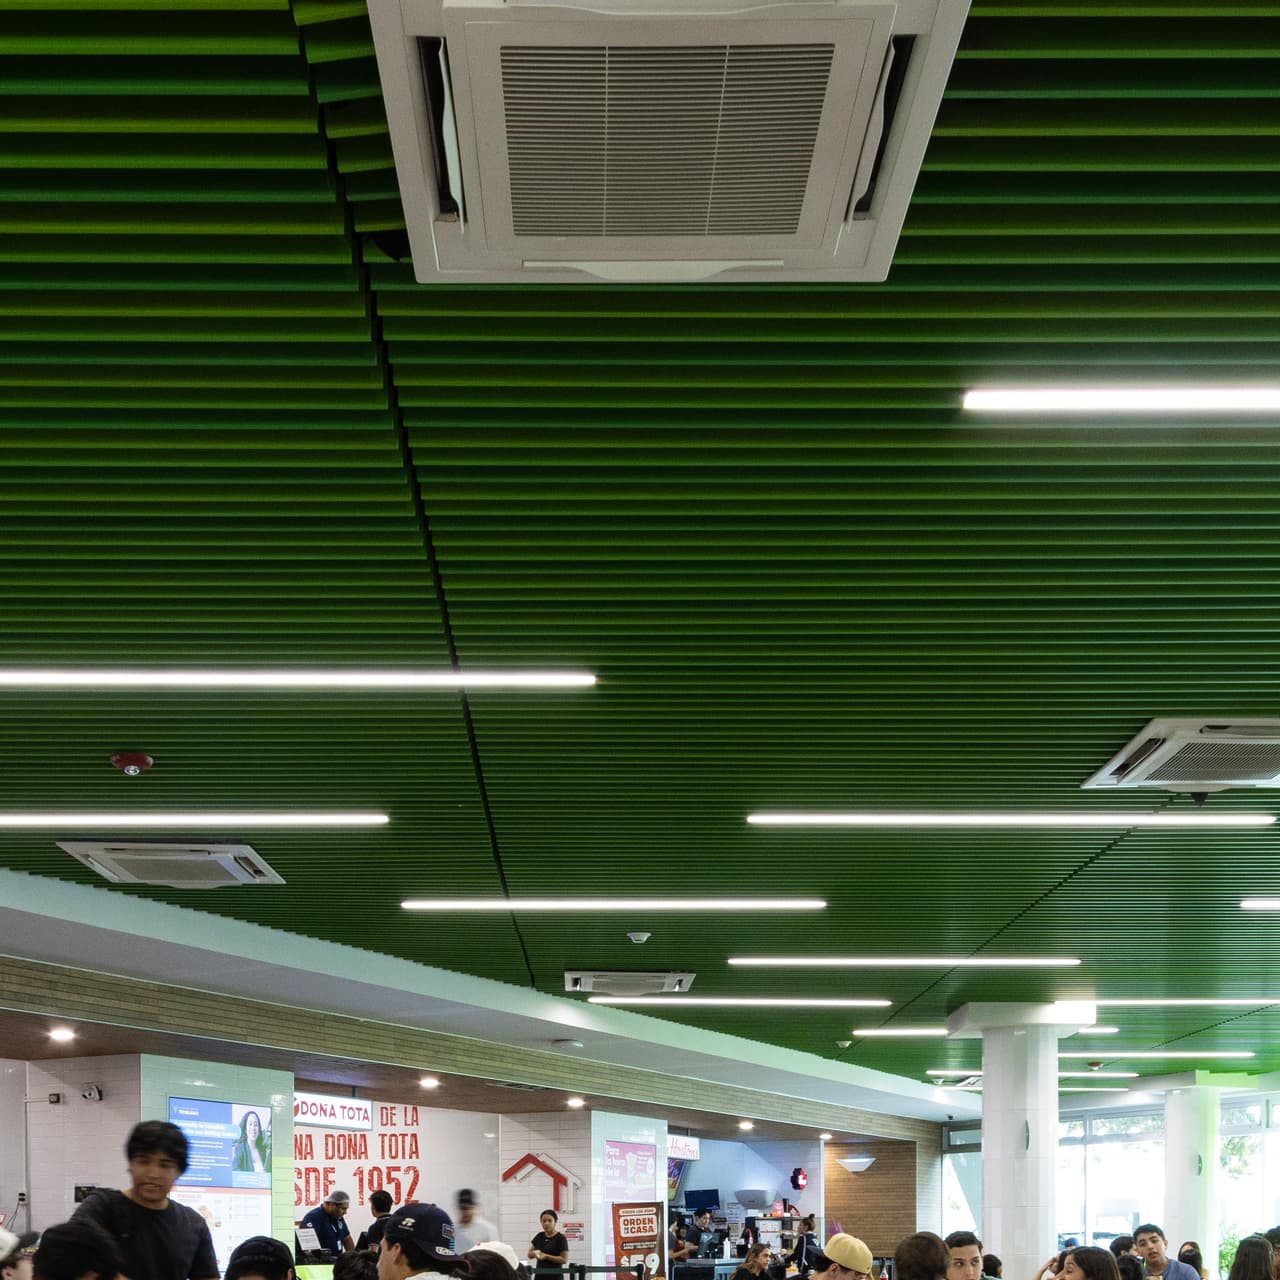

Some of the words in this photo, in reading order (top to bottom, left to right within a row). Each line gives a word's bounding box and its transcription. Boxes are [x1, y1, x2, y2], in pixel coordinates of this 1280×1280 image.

[301, 1101, 337, 1119] DOÑA
[339, 1105, 370, 1122] TOTA
[380, 1106, 396, 1126] DE
[404, 1106, 419, 1126] LA
[378, 1133, 419, 1160] TOTA
[353, 1166, 419, 1206] 1952
[623, 1218, 654, 1226] ORDEN
[630, 1226, 655, 1234] CASA
